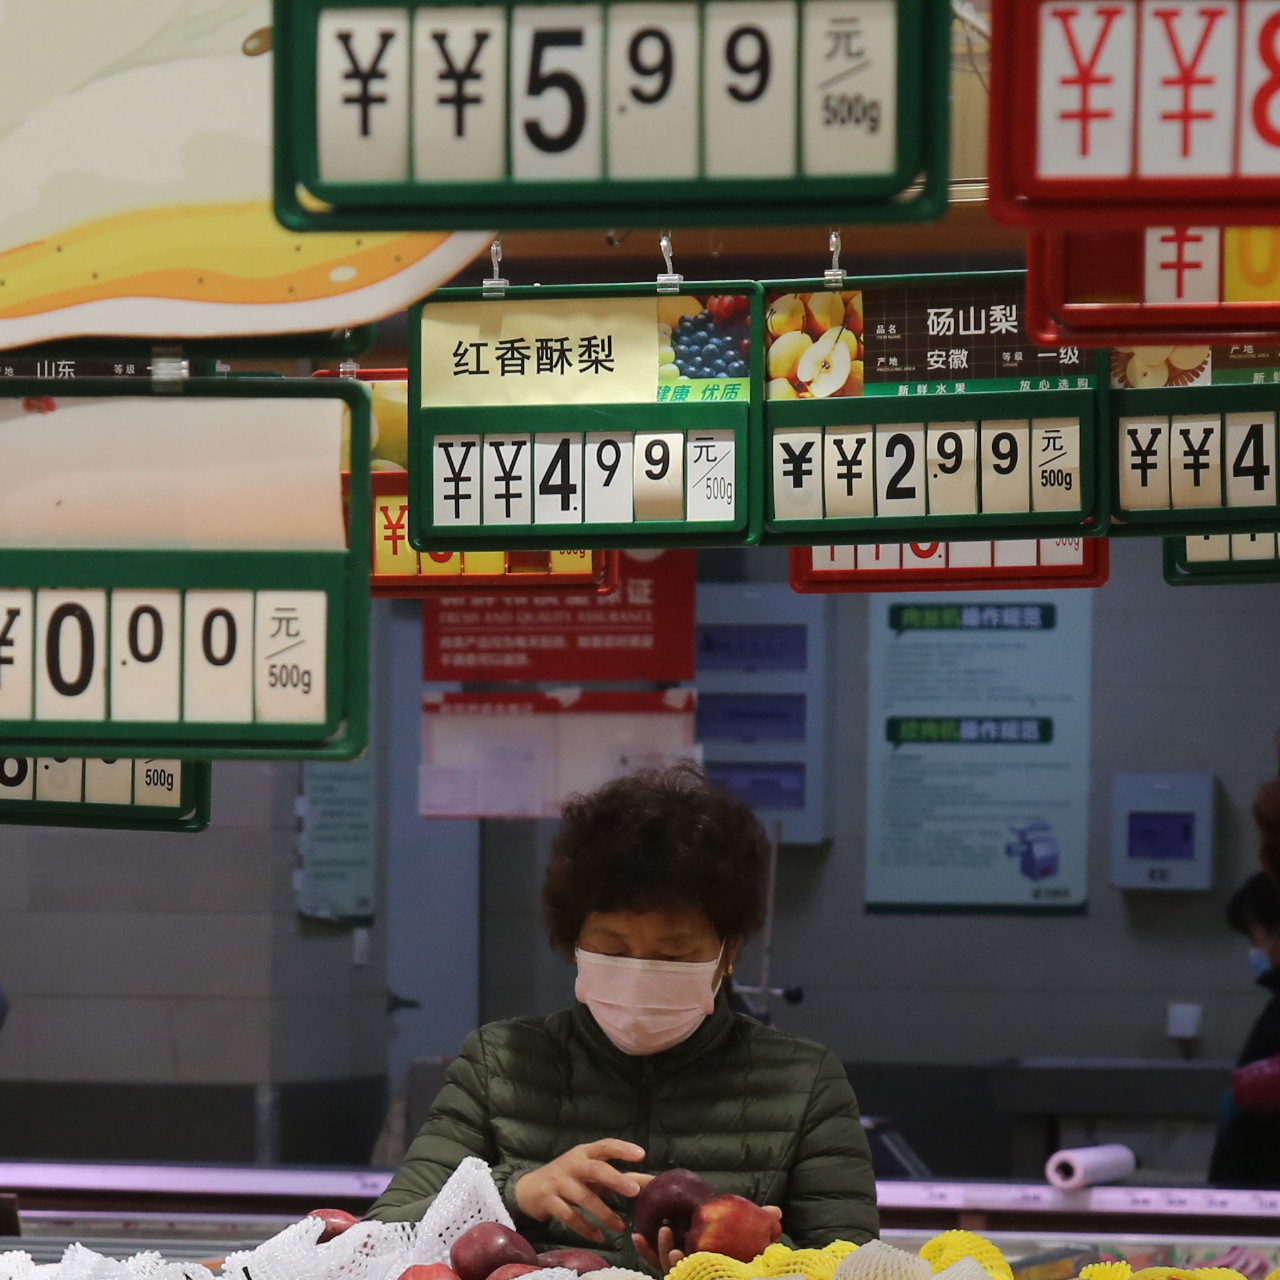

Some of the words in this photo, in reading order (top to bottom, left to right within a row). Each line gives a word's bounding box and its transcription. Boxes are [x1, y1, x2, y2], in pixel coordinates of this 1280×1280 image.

[876, 324, 898, 335] 品名
[926, 303, 1019, 338] 砀山梨
[451, 334, 615, 377] 红香酥梨
[876, 356, 899, 367] 产地
[926, 349, 969, 371] 安徽
[1002, 351, 1024, 362] 等级
[1037, 345, 1080, 365] 一级
[36, 359, 76, 379] 山东
[701, 383, 742, 401] 优质
[898, 382, 967, 396] 新鲜水果
[1019, 377, 1089, 392] 放心选购
